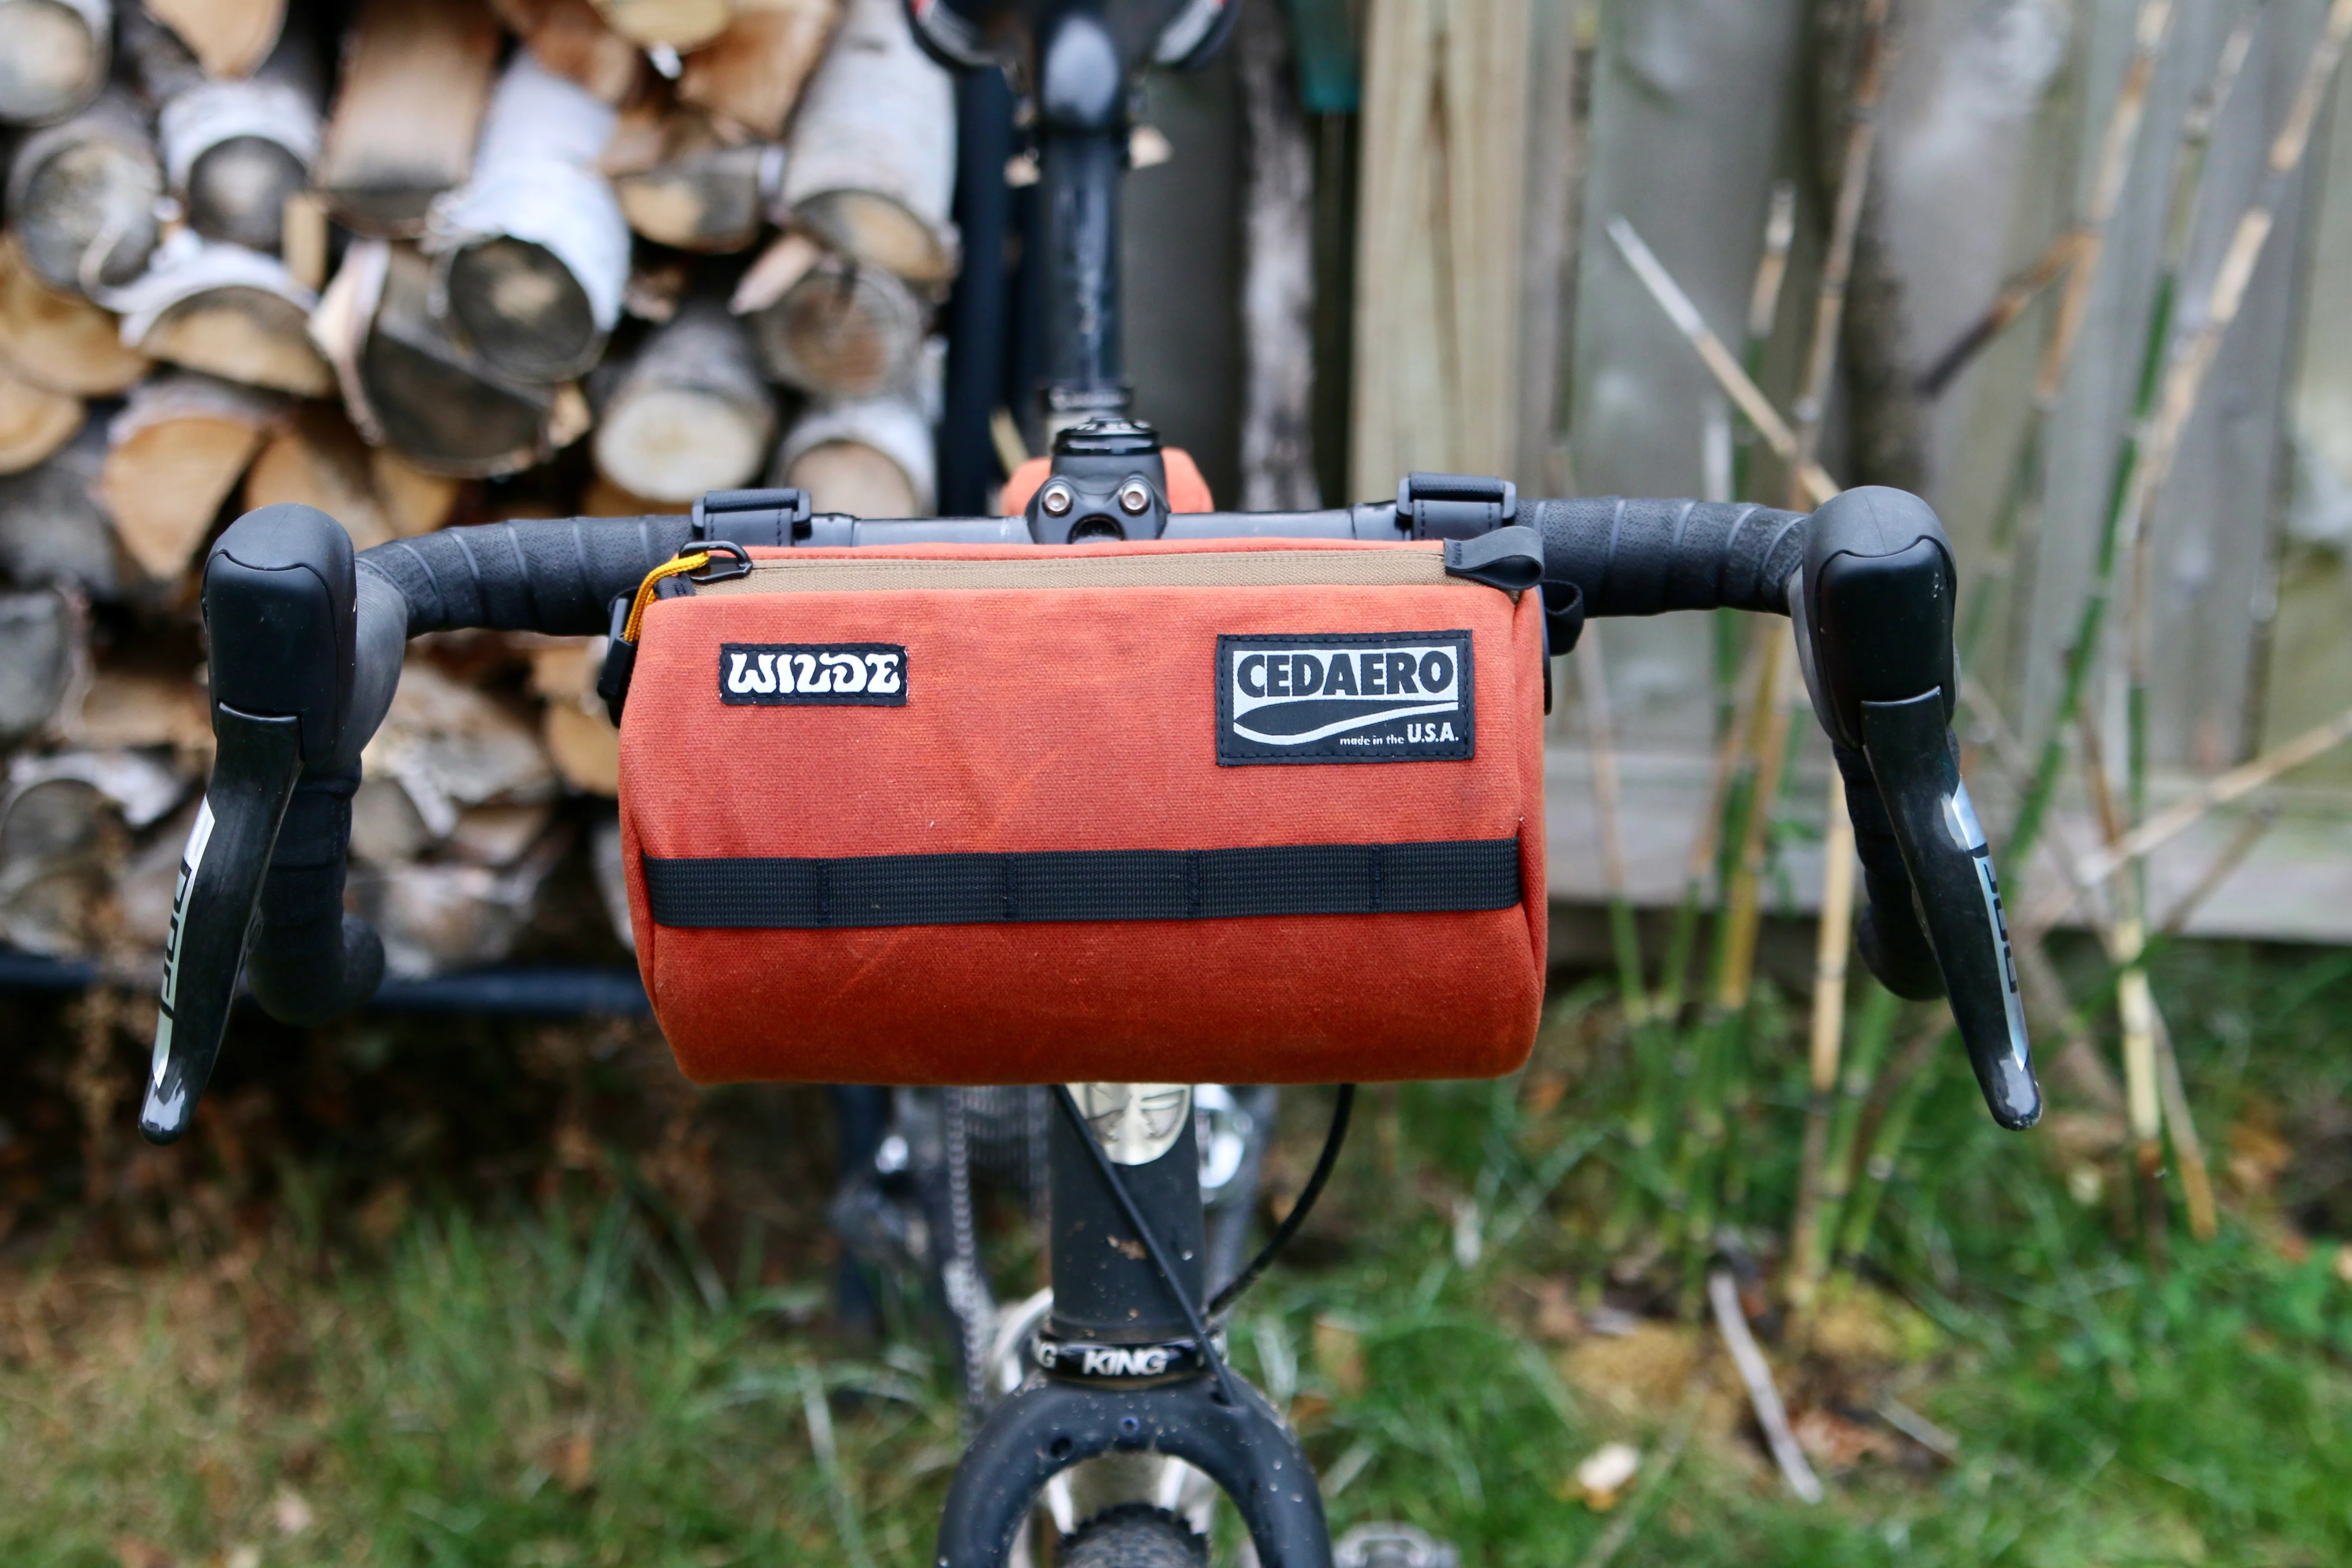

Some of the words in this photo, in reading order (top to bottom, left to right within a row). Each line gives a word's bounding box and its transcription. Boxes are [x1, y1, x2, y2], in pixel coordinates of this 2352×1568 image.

[728, 653, 900, 693] WILDE
[1237, 650, 1454, 697] CEDAERO
[1340, 736, 1370, 745] made
[1372, 735, 1383, 745] in
[1386, 734, 1405, 744] the
[1407, 722, 1459, 743] U.S.A.
[1083, 1348, 1169, 1375] KING
